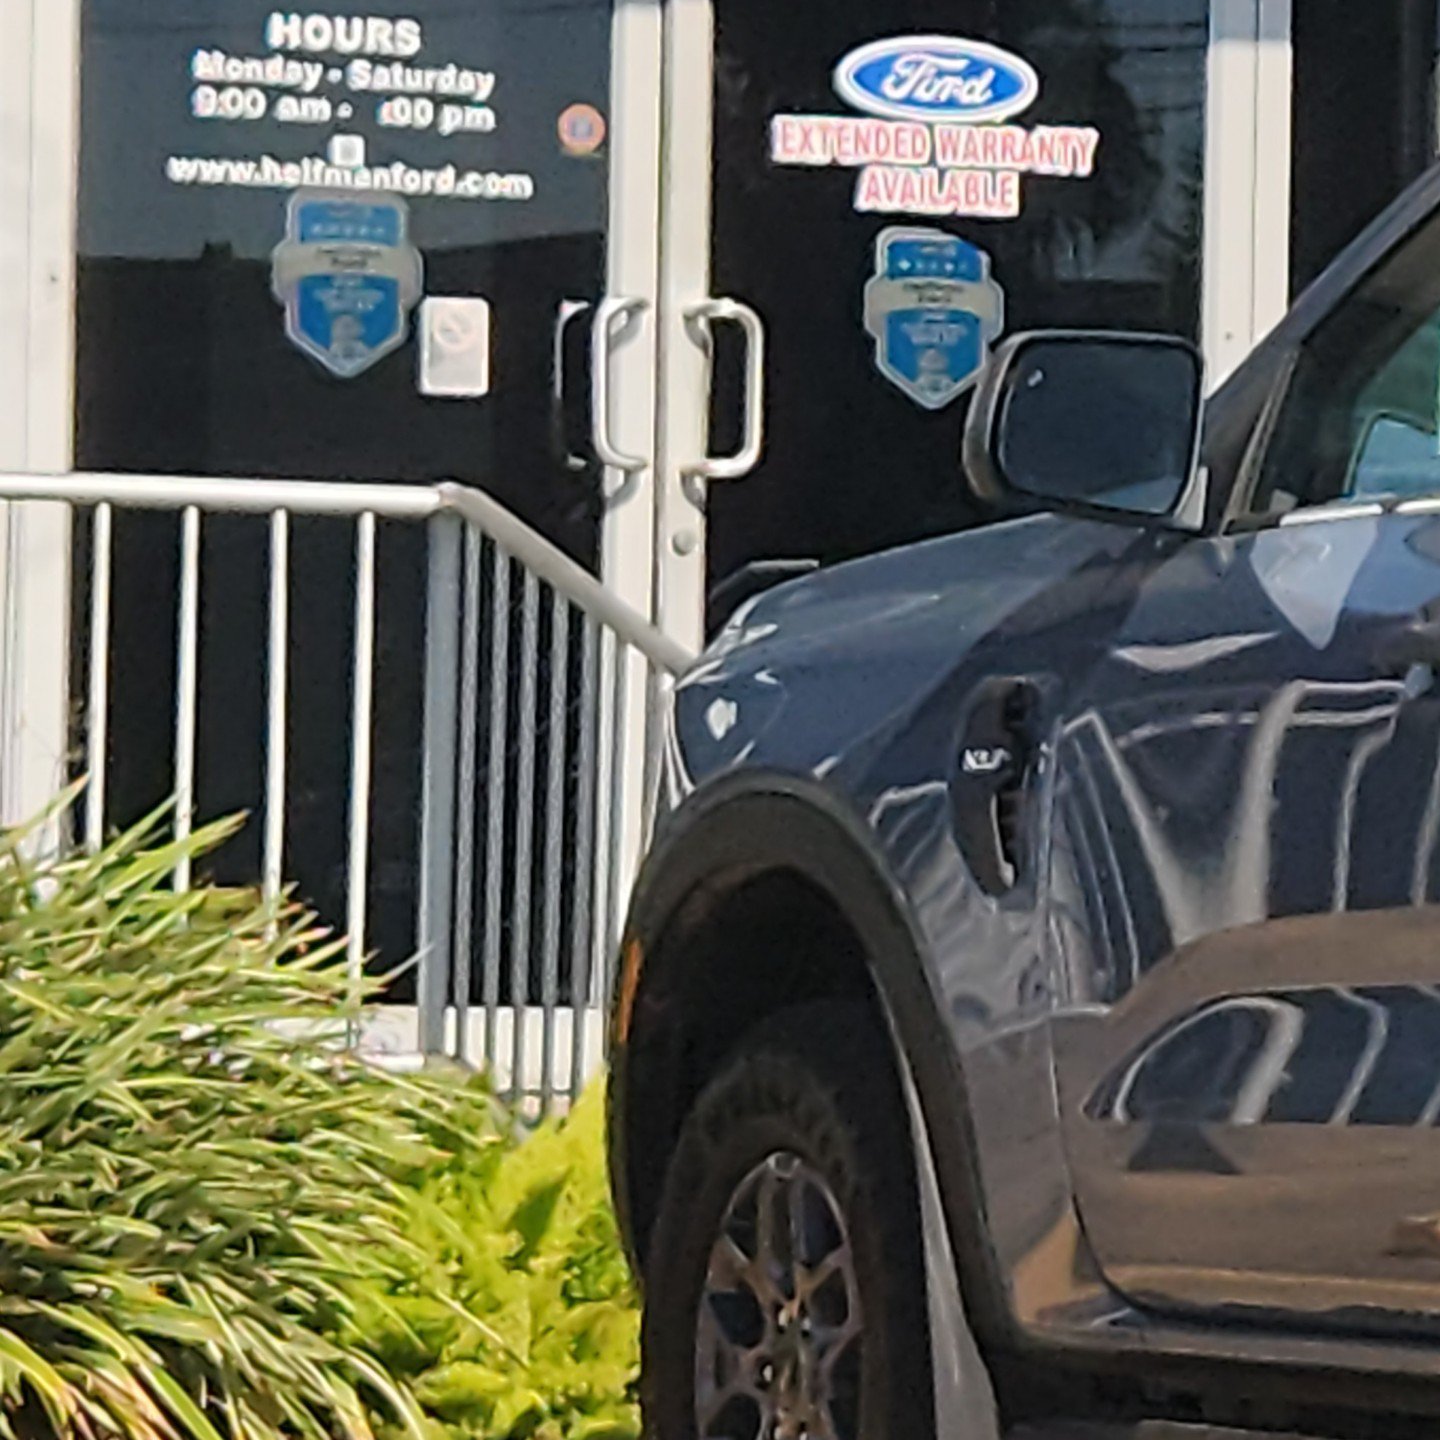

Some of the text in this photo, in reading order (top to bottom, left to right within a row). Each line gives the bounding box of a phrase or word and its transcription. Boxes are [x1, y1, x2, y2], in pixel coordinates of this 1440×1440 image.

[266, 11, 421, 56] HOURS
[191, 48, 323, 92] Monday
[345, 57, 496, 102] Saturday
[880, 51, 996, 106] Ford
[275, 94, 332, 123] am
[437, 102, 497, 137] pm
[775, 117, 1095, 175] EXTENDED WARRANTY
[860, 170, 1018, 216] AVAILABLE
